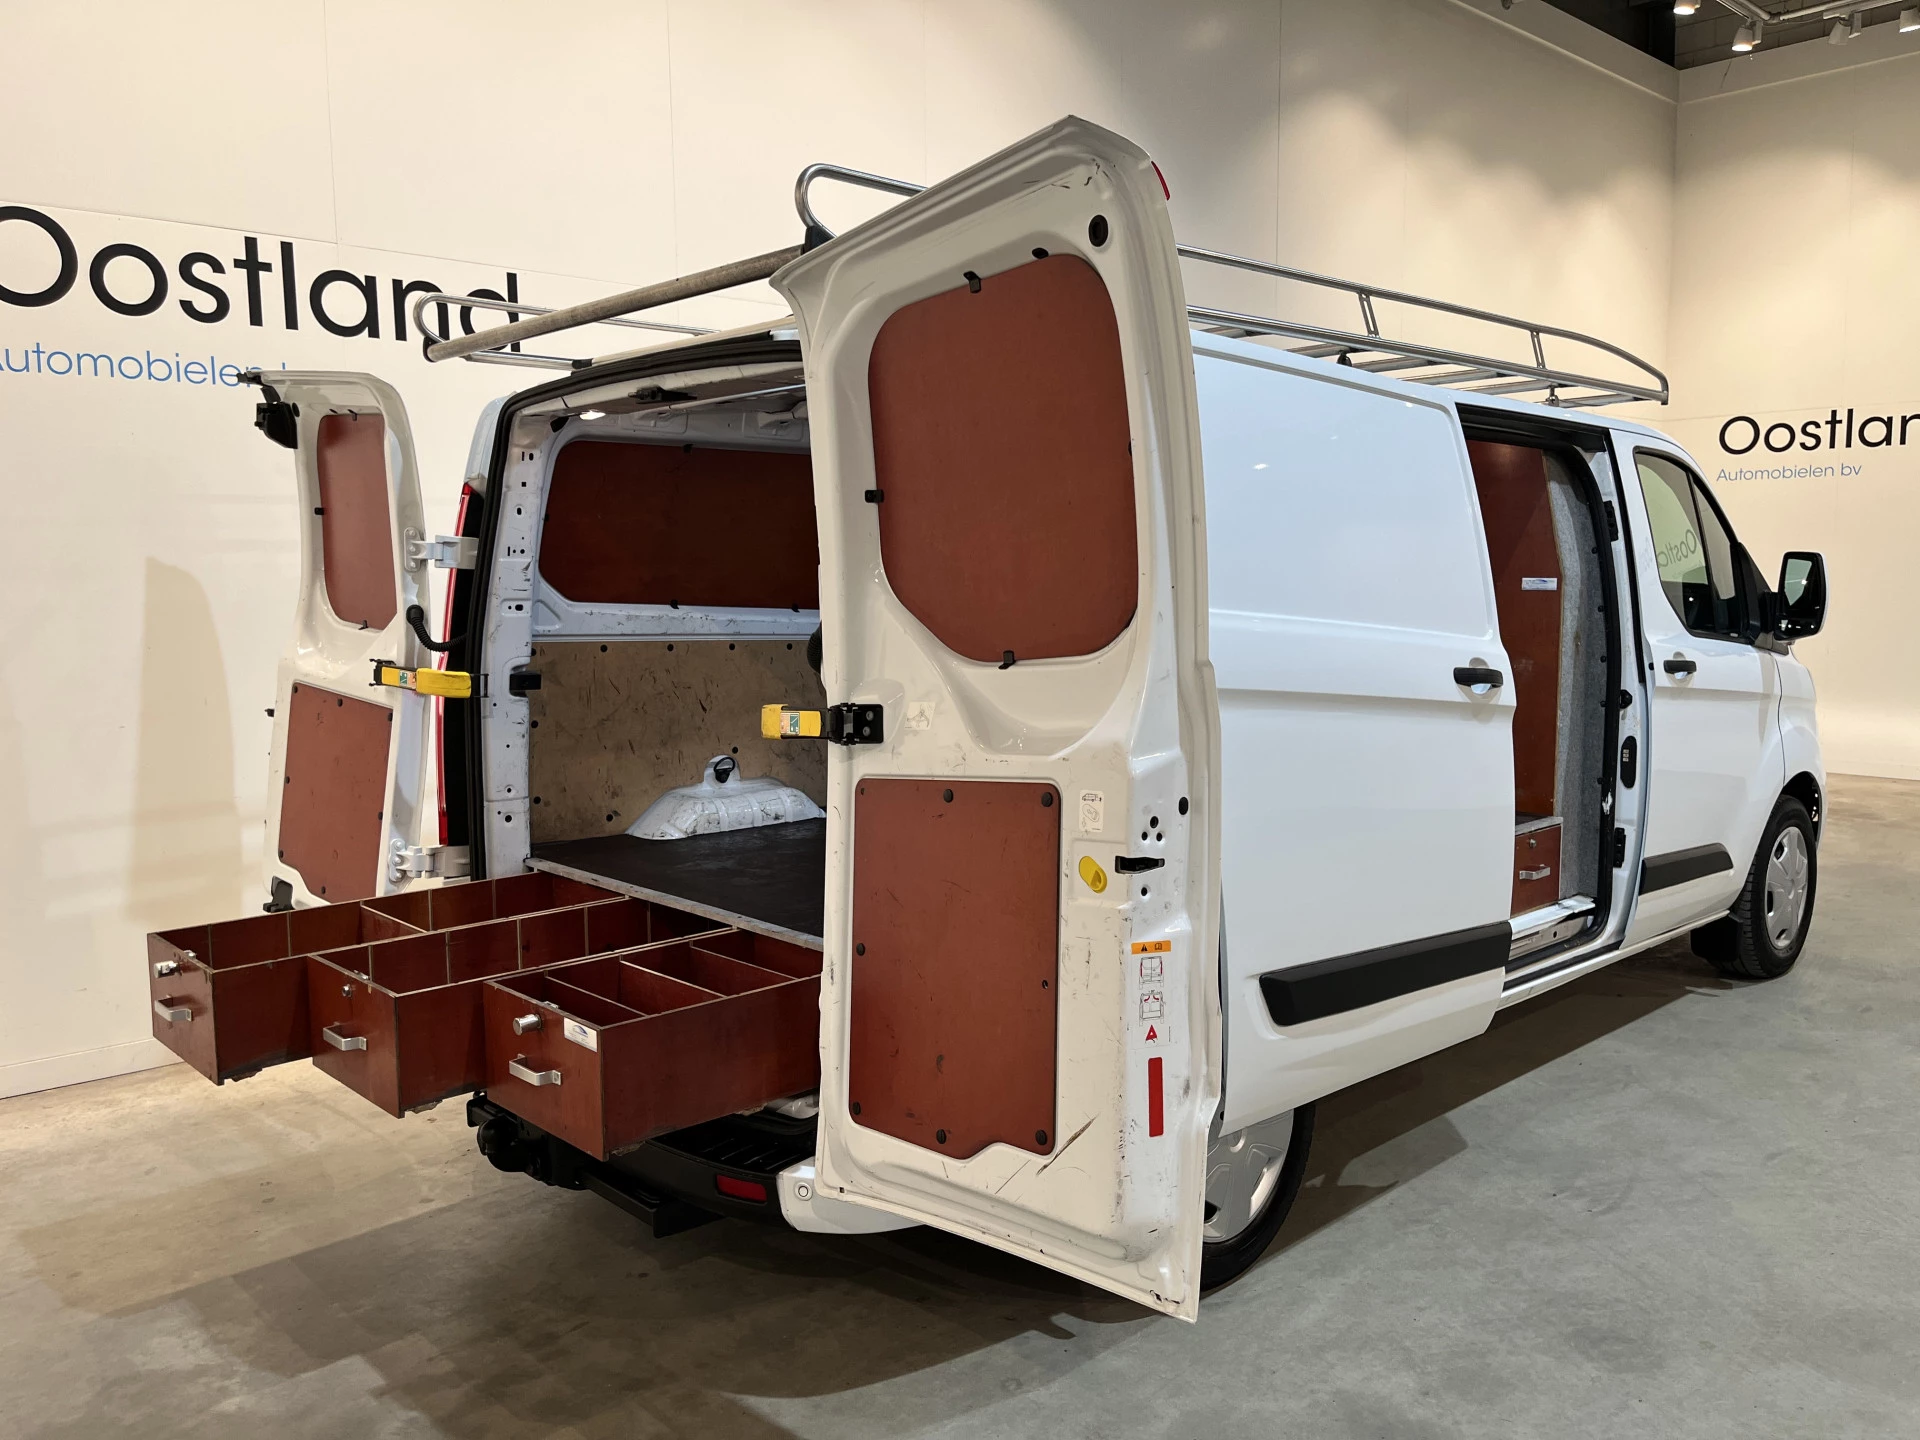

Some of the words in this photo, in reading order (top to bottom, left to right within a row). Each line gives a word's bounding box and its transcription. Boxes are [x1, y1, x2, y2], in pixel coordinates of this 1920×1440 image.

[0, 205, 521, 353] Oostland
[0, 342, 263, 387] utomobiele
[1716, 464, 1835, 482] Automobielen
[1840, 462, 1863, 477] bv
